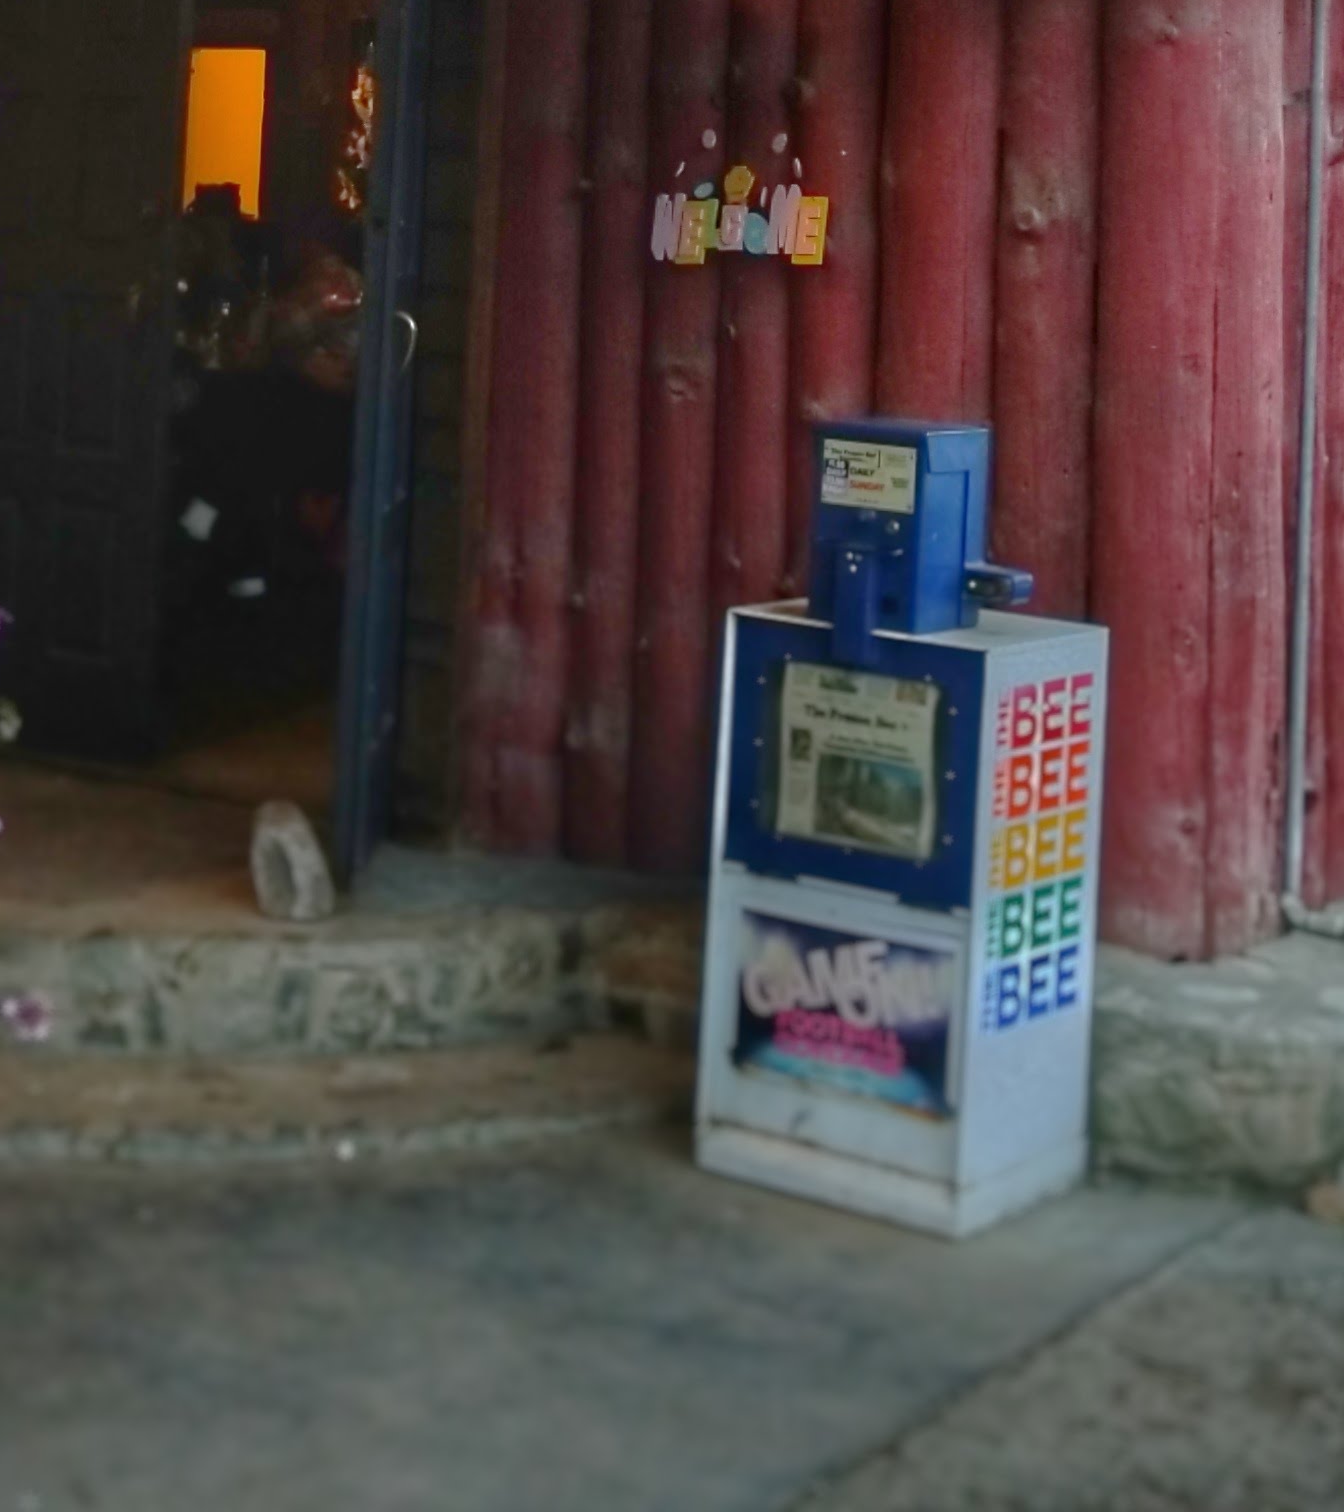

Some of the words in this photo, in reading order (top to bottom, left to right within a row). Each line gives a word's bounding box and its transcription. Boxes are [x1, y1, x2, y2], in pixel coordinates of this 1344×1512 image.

[1012, 673, 1094, 749] BEE
[1008, 741, 1091, 820] BEE
[1003, 807, 1086, 889] BEE
[1000, 875, 1083, 958] BEE
[997, 944, 1080, 1030] BEE
